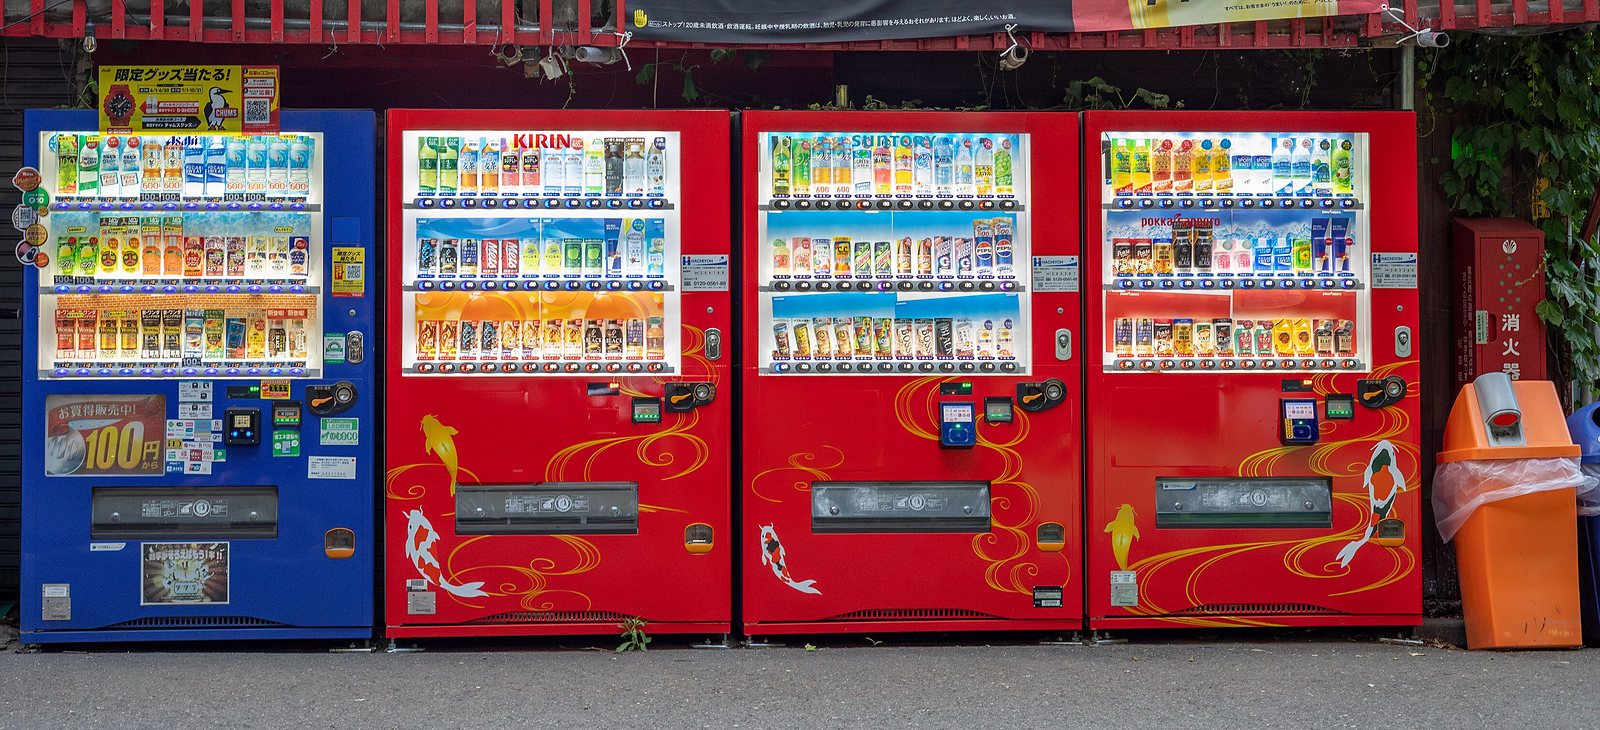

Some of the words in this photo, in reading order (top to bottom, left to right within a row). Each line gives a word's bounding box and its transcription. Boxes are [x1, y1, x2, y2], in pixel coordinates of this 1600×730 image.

[114, 68, 231, 81] 限定グッズ当たる!
[166, 136, 198, 147] Asahi
[514, 134, 570, 148] KIRIN
[852, 135, 936, 147] SUNTORY
[902, 329, 912, 354] BOSS
[922, 329, 932, 354] BOSS
[1502, 314, 1520, 380] 消火器
[58, 404, 136, 419] お買得販売中!
[86, 421, 160, 470] 100円
